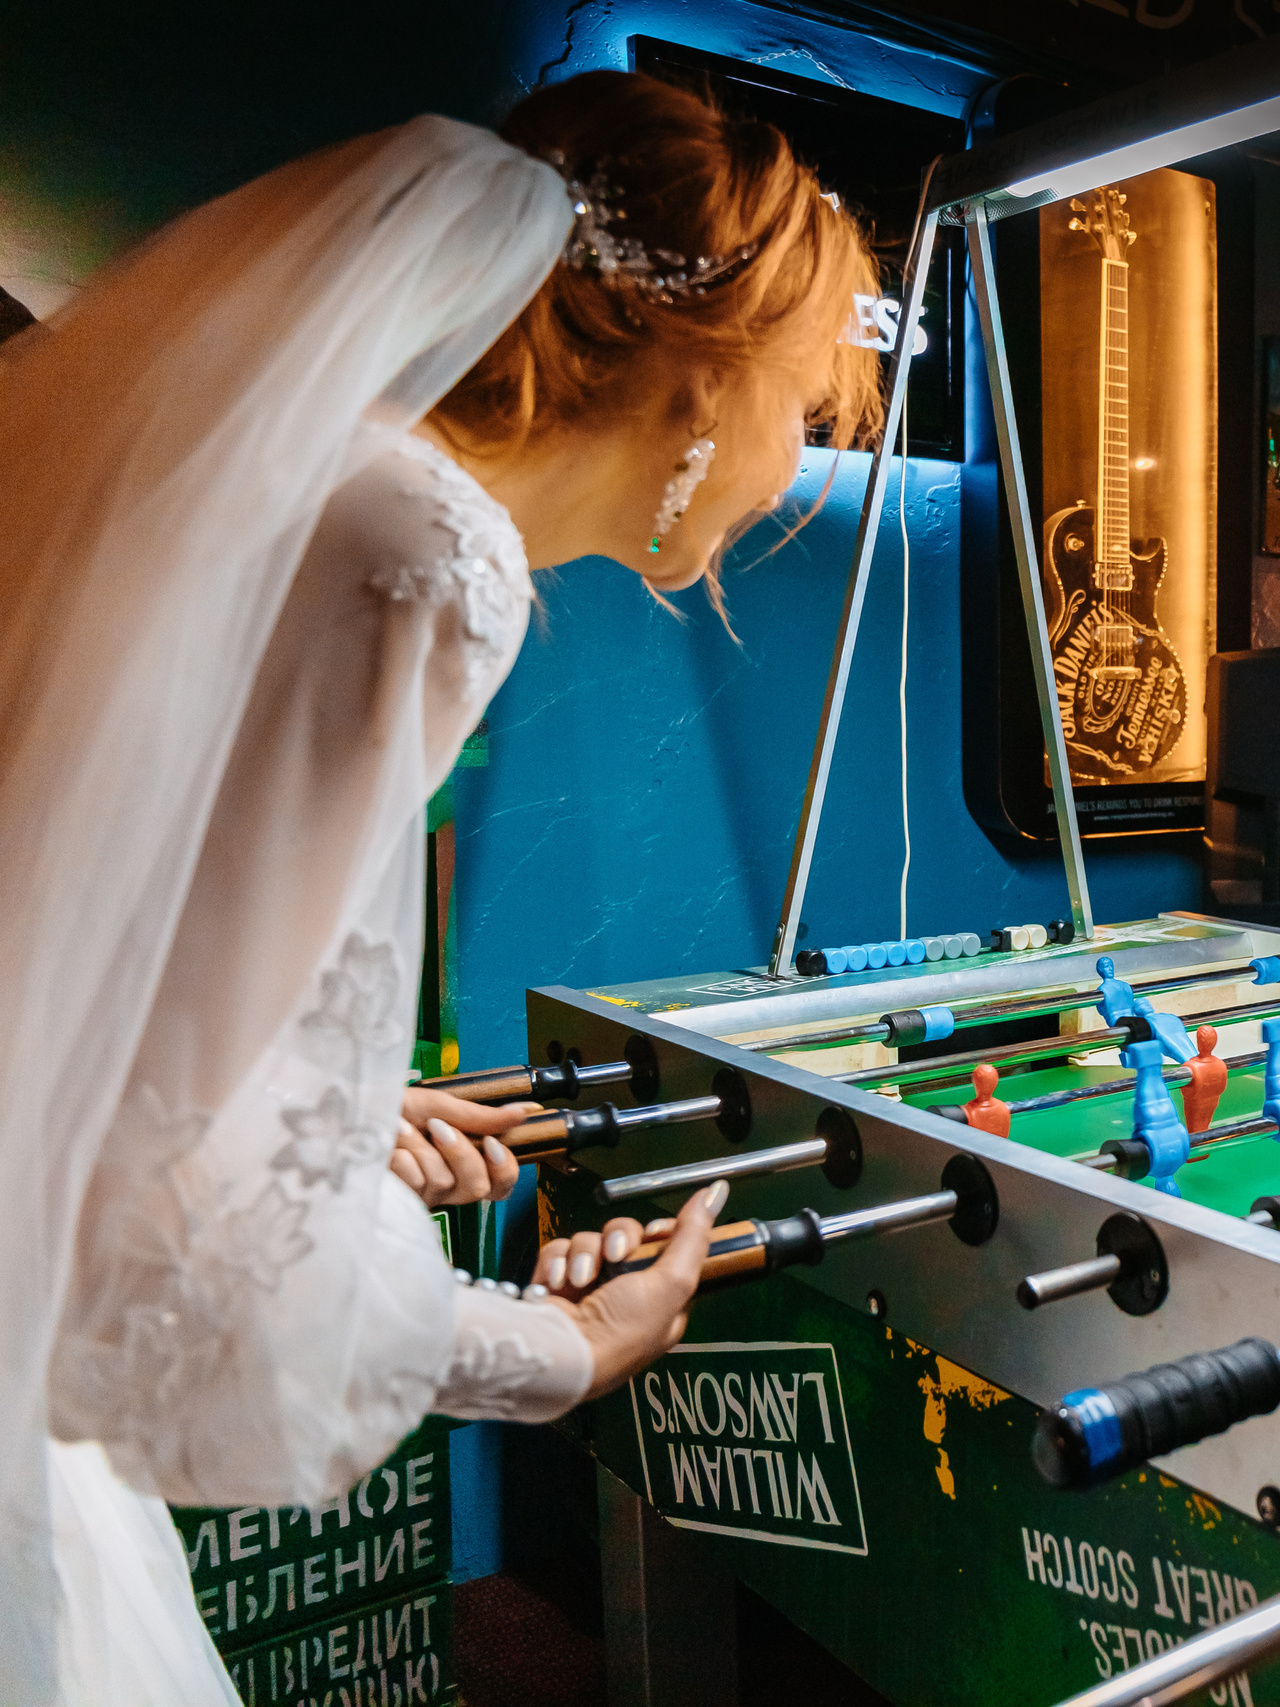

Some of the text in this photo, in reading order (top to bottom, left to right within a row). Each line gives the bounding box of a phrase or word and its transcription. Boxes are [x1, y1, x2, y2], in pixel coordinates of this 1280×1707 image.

[1054, 677, 1077, 739] JACK
[1077, 675, 1088, 700] OLD
[1115, 655, 1164, 750] Tennessee
[1137, 662, 1181, 763] WHISKEY
[644, 1369, 843, 1527] WILLIAM LAWSON'S
[1021, 1526, 1259, 1629] GREAT SCOTCH
[269, 1595, 437, 1702] ВРЕДИТ
[1079, 1618, 1187, 1681] ULES.
